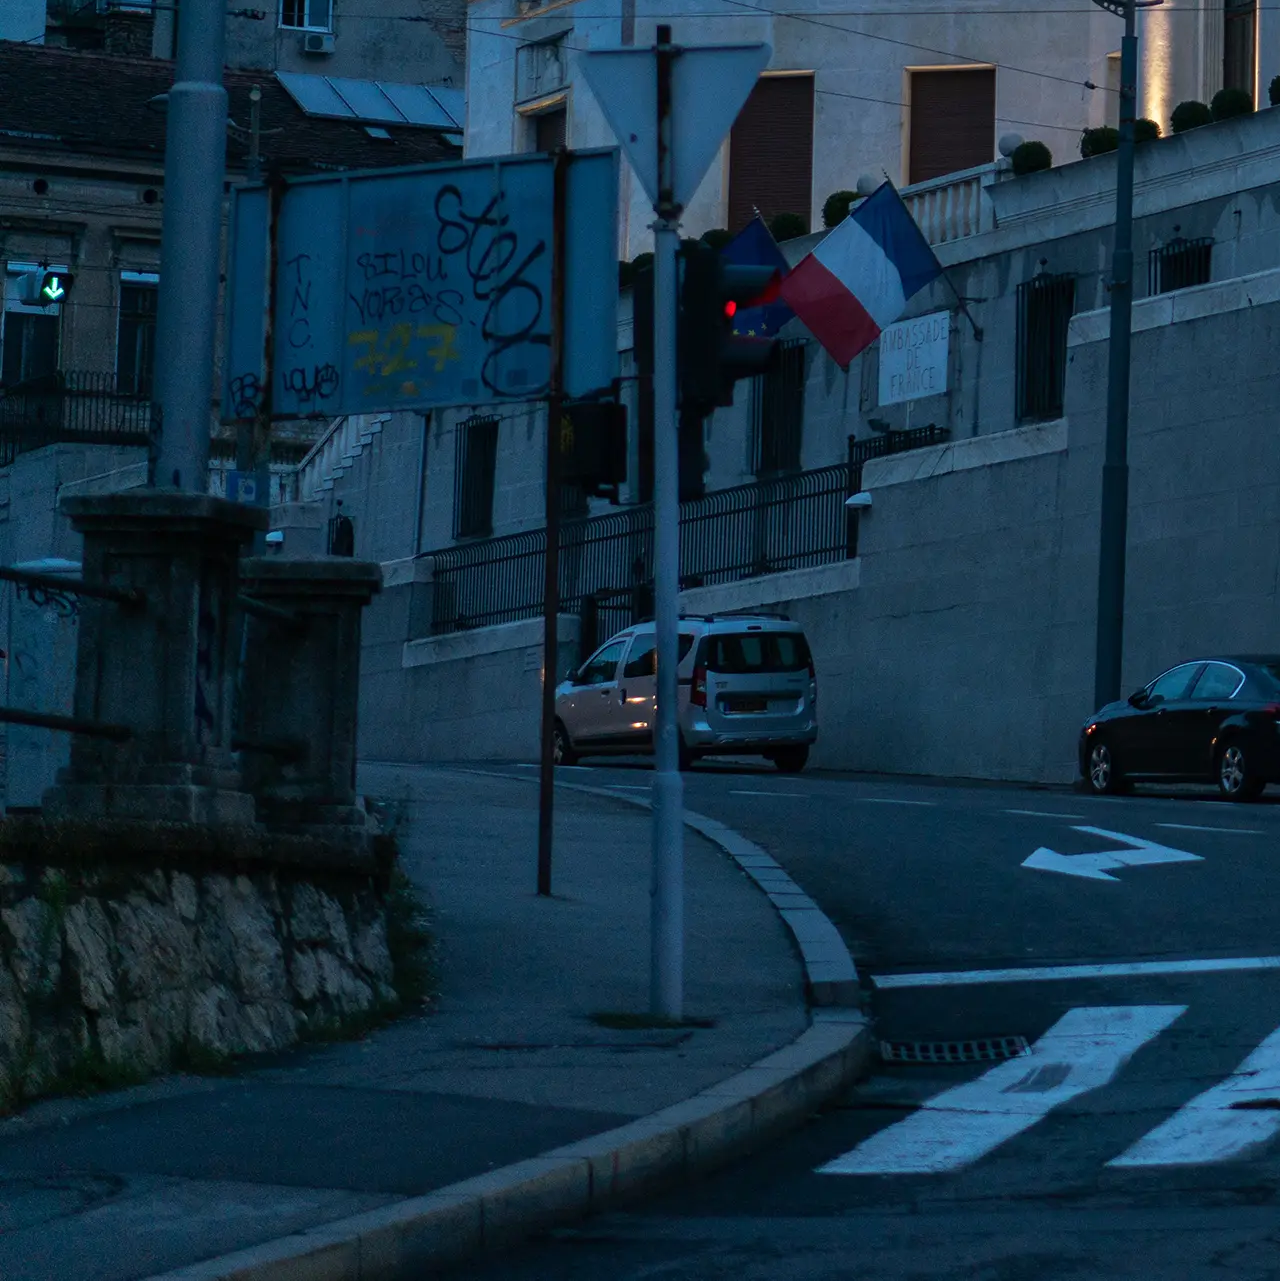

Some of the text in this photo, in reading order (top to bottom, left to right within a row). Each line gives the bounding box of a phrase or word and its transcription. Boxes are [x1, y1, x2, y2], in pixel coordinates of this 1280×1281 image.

[882, 317, 948, 354] AMBASSADE
[906, 346, 922, 371] DE
[891, 366, 935, 398] FRANCE
